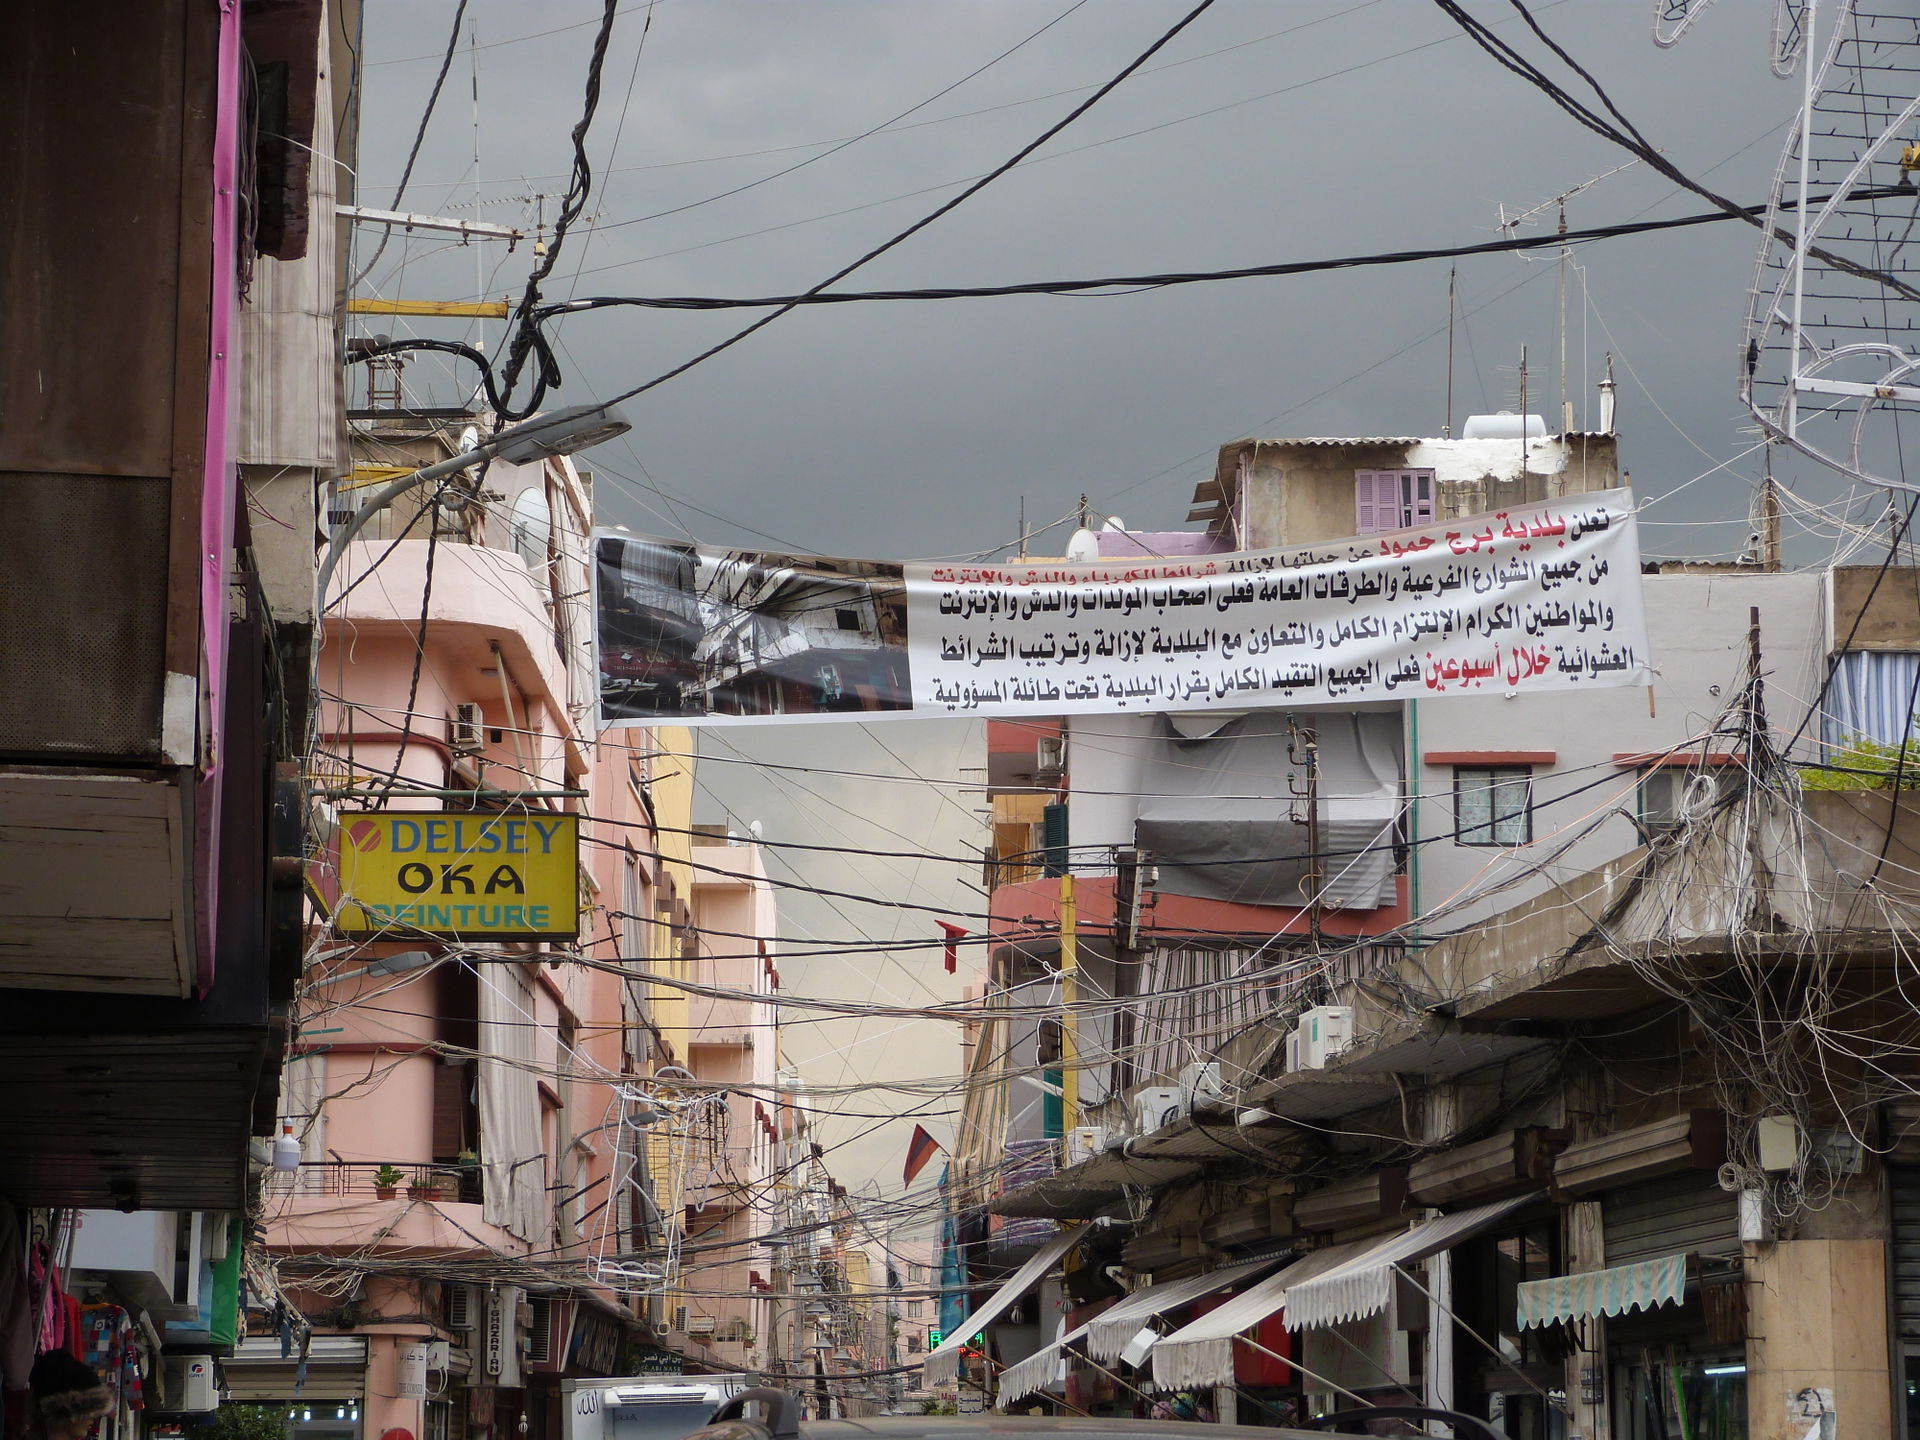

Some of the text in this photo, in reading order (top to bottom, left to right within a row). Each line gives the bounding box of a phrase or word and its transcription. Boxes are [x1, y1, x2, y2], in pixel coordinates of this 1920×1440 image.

[1445, 526, 1494, 555] برج
[1496, 510, 1566, 552] بلدية
[1571, 507, 1610, 541] تعلن
[1281, 551, 1339, 569] حملتها
[1348, 547, 1373, 564] عن
[1380, 536, 1435, 558] حمود
[1019, 568, 1077, 586] والدش
[1082, 567, 1156, 586] الكهرباء
[1403, 564, 1469, 601] الفرعية
[1473, 556, 1536, 594] الشوارع
[1540, 559, 1582, 591] جميع
[1588, 554, 1609, 586] من
[1022, 588, 1078, 620] والدش
[1081, 586, 1148, 616] المولدات
[1216, 578, 1255, 612] فعلى
[1258, 575, 1310, 602] العامة
[1314, 570, 1399, 605] والطرقات
[939, 588, 1018, 623] والإنترنت
[940, 598, 1614, 668] والمواطنين الكرام الإلتزام الكامل والتعاون مع البلدية لإزالة وترتيب الشرائط
[1327, 658, 1380, 697] الجميع
[1384, 654, 1421, 690] فعلى
[1425, 642, 1502, 692] أسبوعين
[1506, 643, 1551, 686] خلال
[1555, 642, 1634, 682] العشوائية
[1009, 676, 1061, 702] طائلة
[1064, 675, 1100, 700] تحت
[1102, 673, 1164, 707] البلدية
[1166, 670, 1210, 703] بقرار
[1214, 666, 1267, 699] الكامل
[1271, 662, 1324, 698] التقيد
[391, 818, 564, 855] DELSEY
[398, 862, 526, 894] OKA
